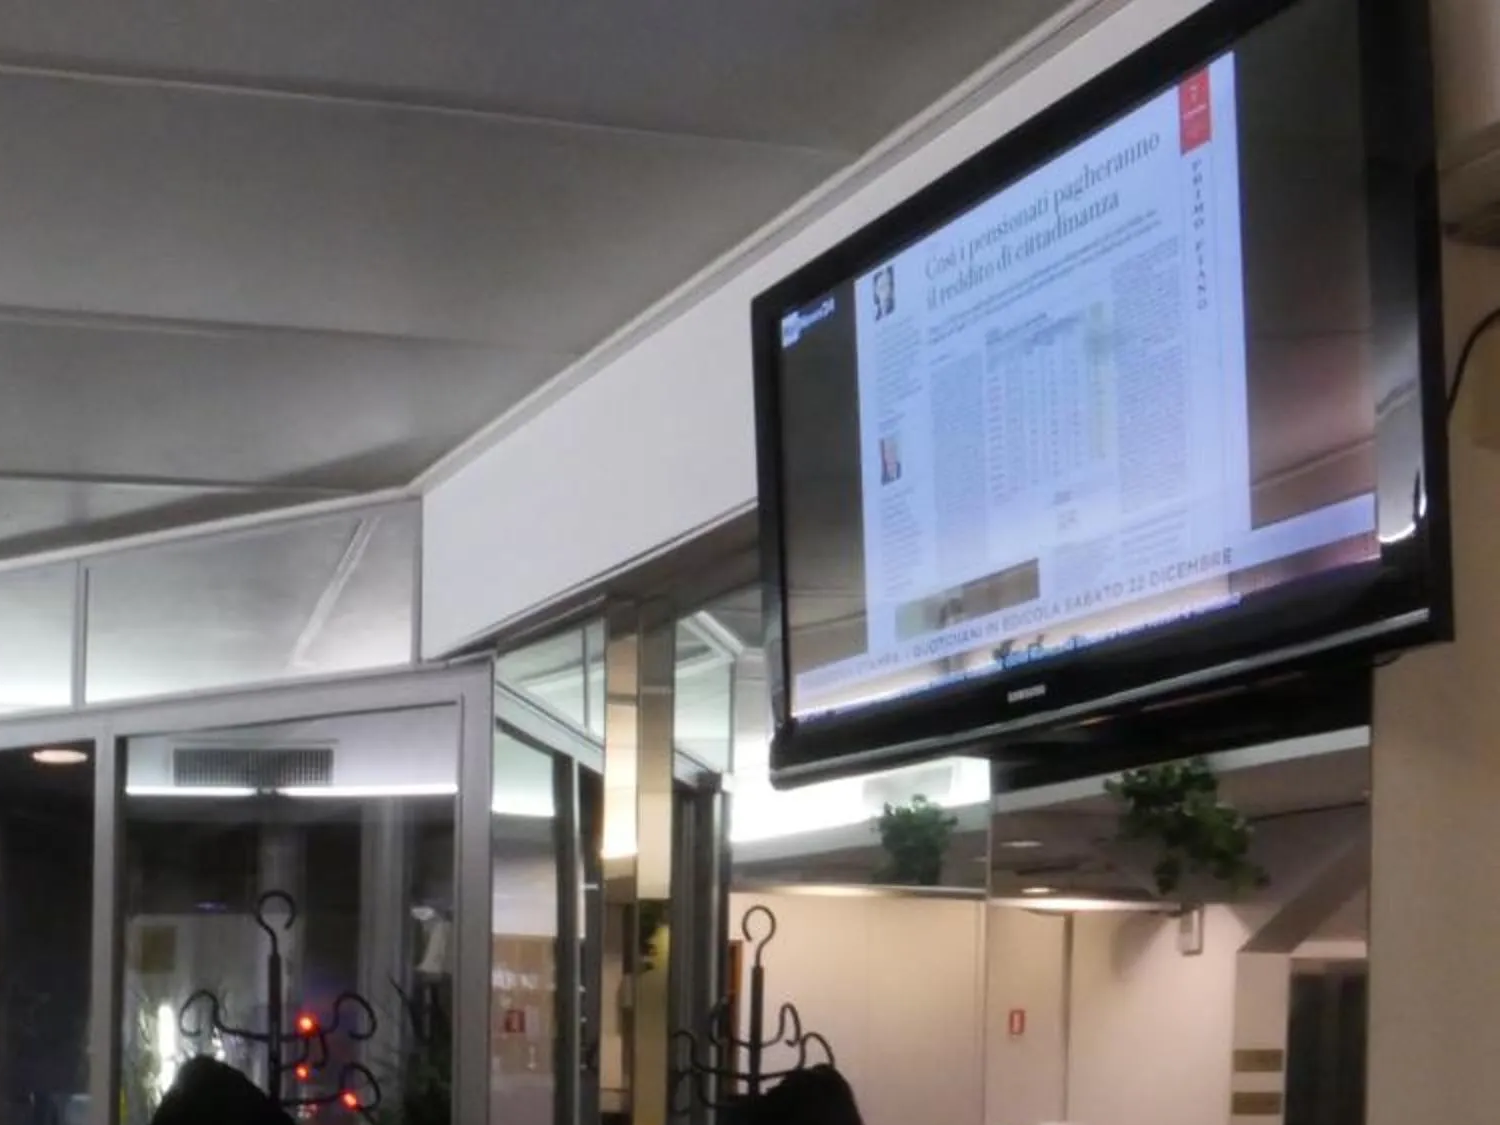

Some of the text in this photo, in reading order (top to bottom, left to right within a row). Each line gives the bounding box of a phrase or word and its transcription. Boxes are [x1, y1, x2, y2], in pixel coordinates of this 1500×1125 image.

[1053, 133, 1161, 214] pagheranno
[997, 245, 1012, 271] di
[1014, 190, 1120, 258] cittadinanza
[1150, 547, 1232, 587] DICEMBRE
